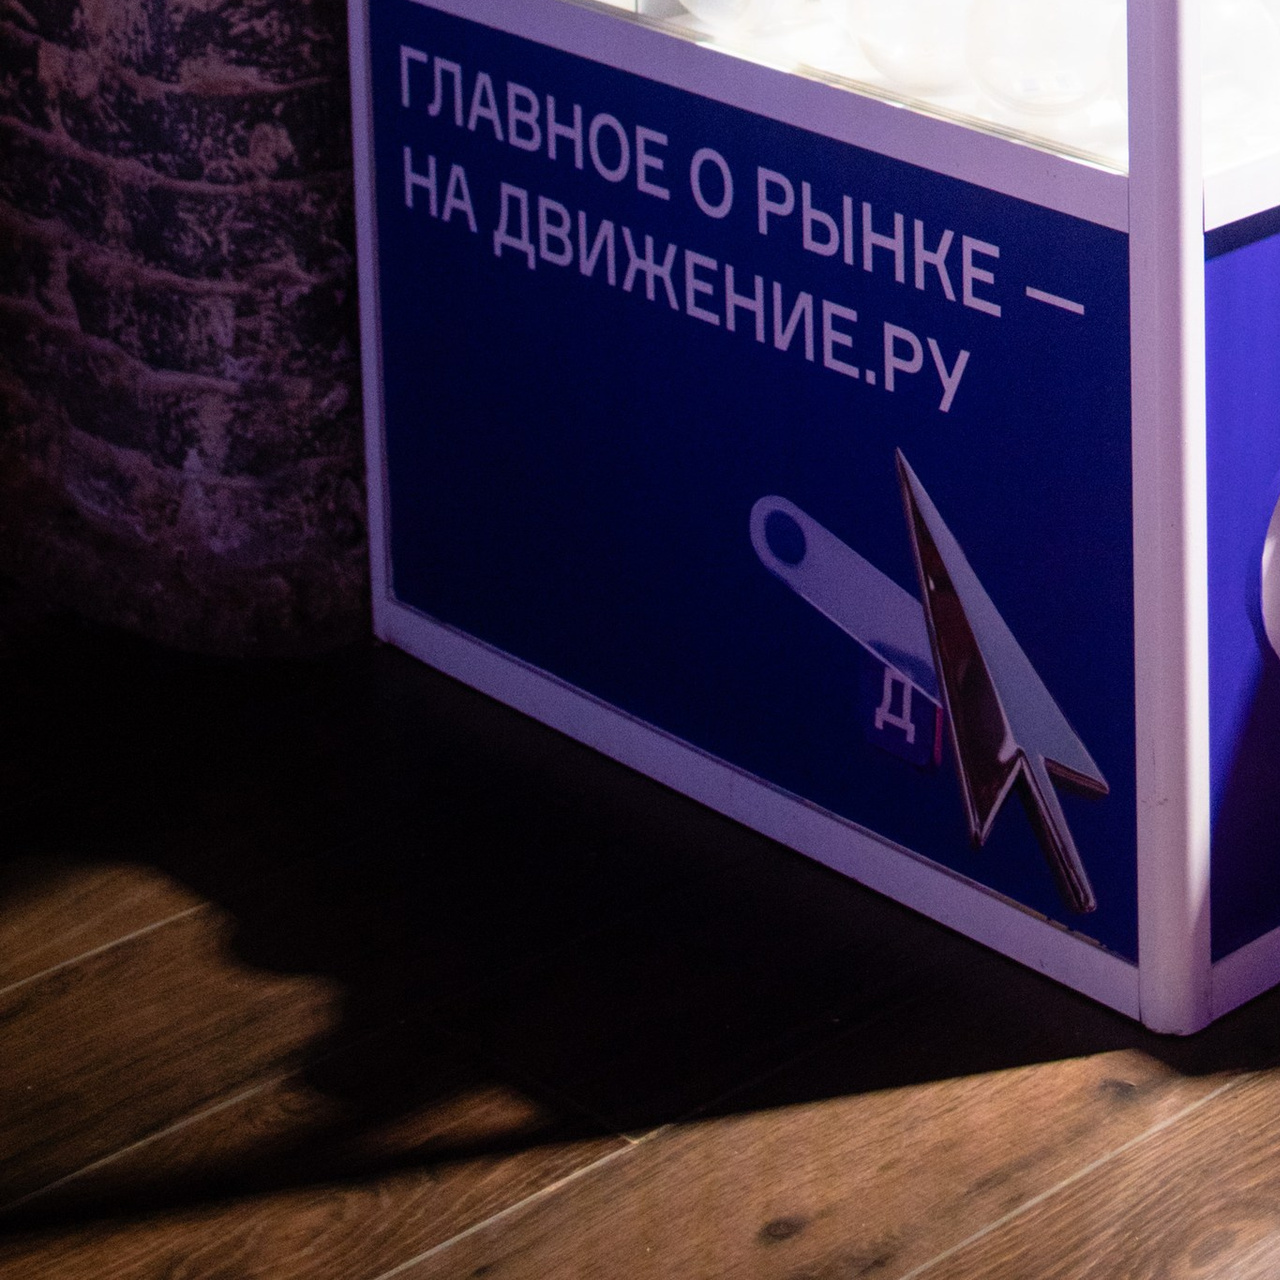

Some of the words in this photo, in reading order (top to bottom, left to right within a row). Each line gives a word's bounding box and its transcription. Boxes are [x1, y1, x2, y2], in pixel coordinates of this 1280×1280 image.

[400, 45, 671, 201] ГЛАВНОЕ
[690, 147, 734, 218] О
[757, 167, 1001, 317] РЫНКЕ
[403, 146, 478, 233] НА
[493, 181, 970, 413] ДВИЖЕНИЕ.РУ
